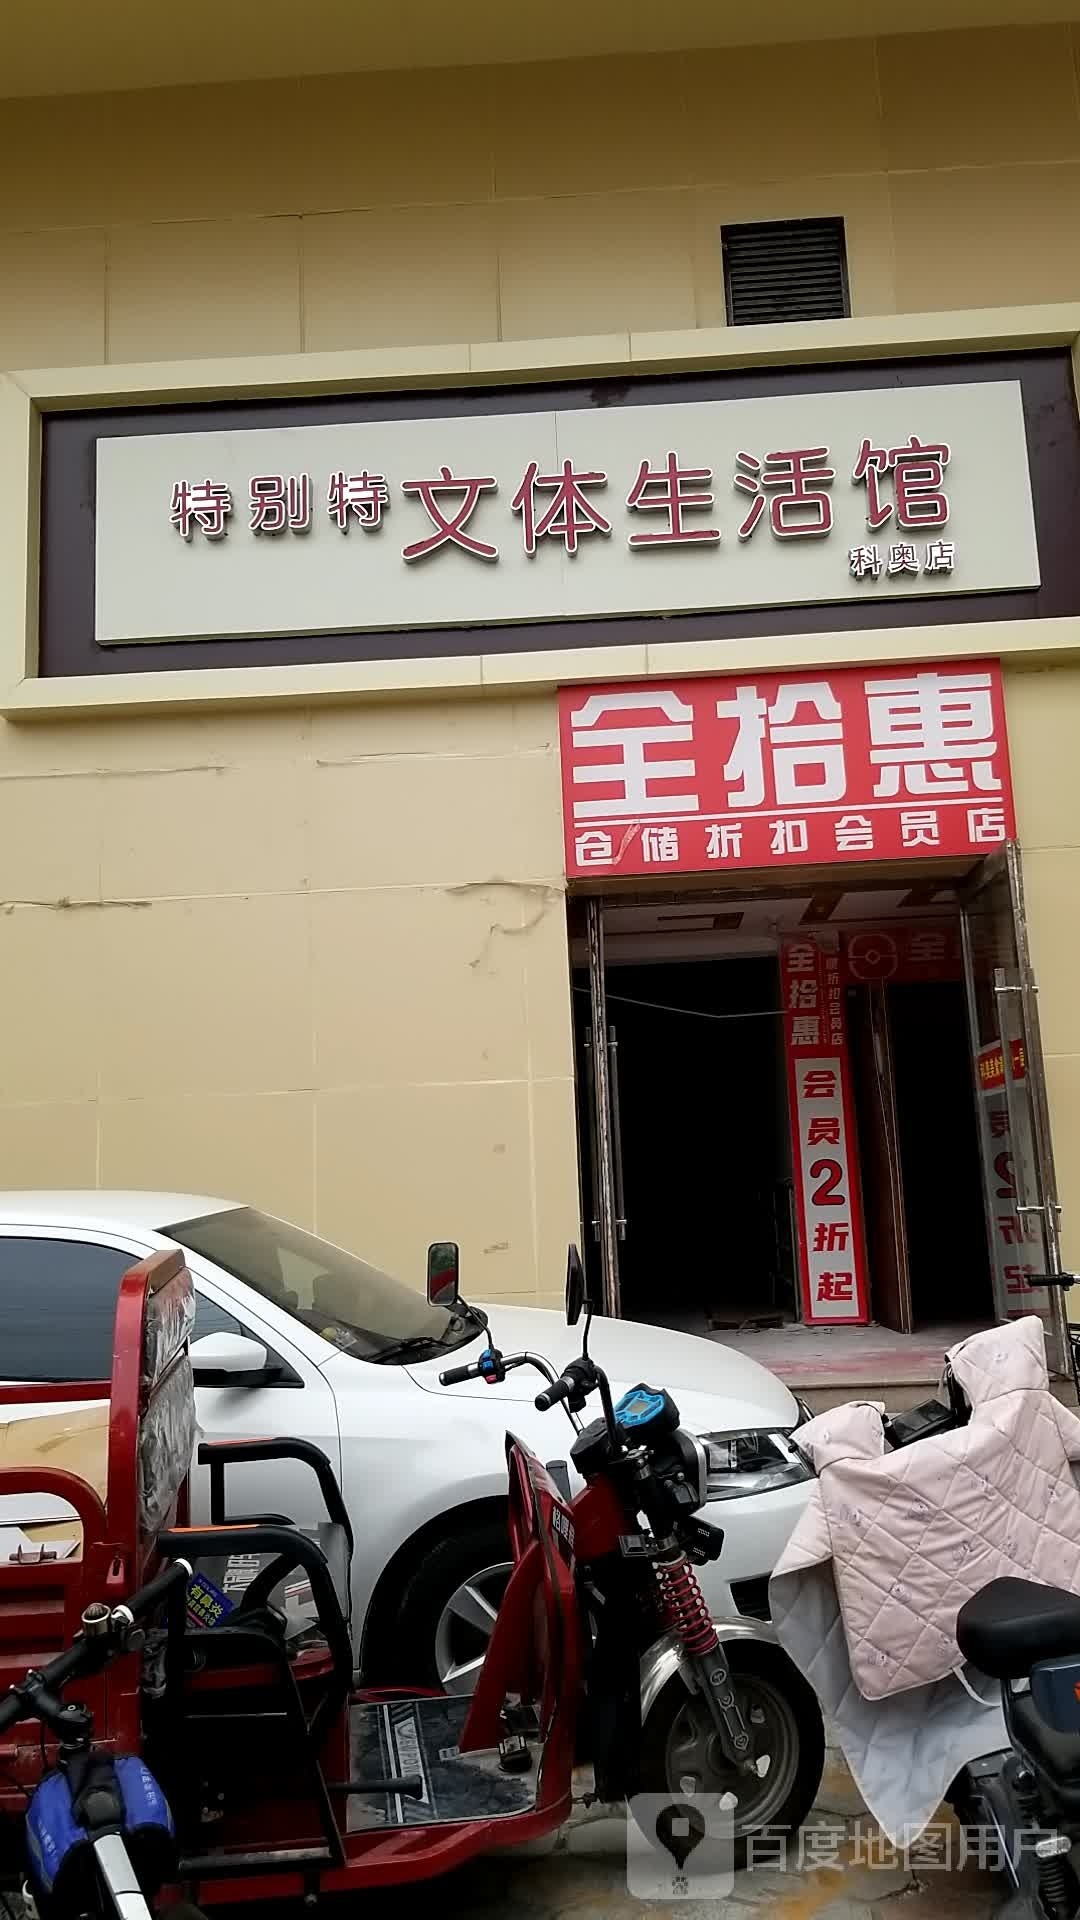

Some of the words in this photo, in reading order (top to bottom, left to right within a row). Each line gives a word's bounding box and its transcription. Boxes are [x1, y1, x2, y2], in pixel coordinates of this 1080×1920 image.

[170, 436, 951, 564] 特别特文体生活馆
[848, 539, 955, 577] 科奥店
[570, 671, 1003, 818] 全拾惠
[574, 807, 1006, 867] 仓储折扣会员店
[803, 1069, 854, 1302] 会员2折起
